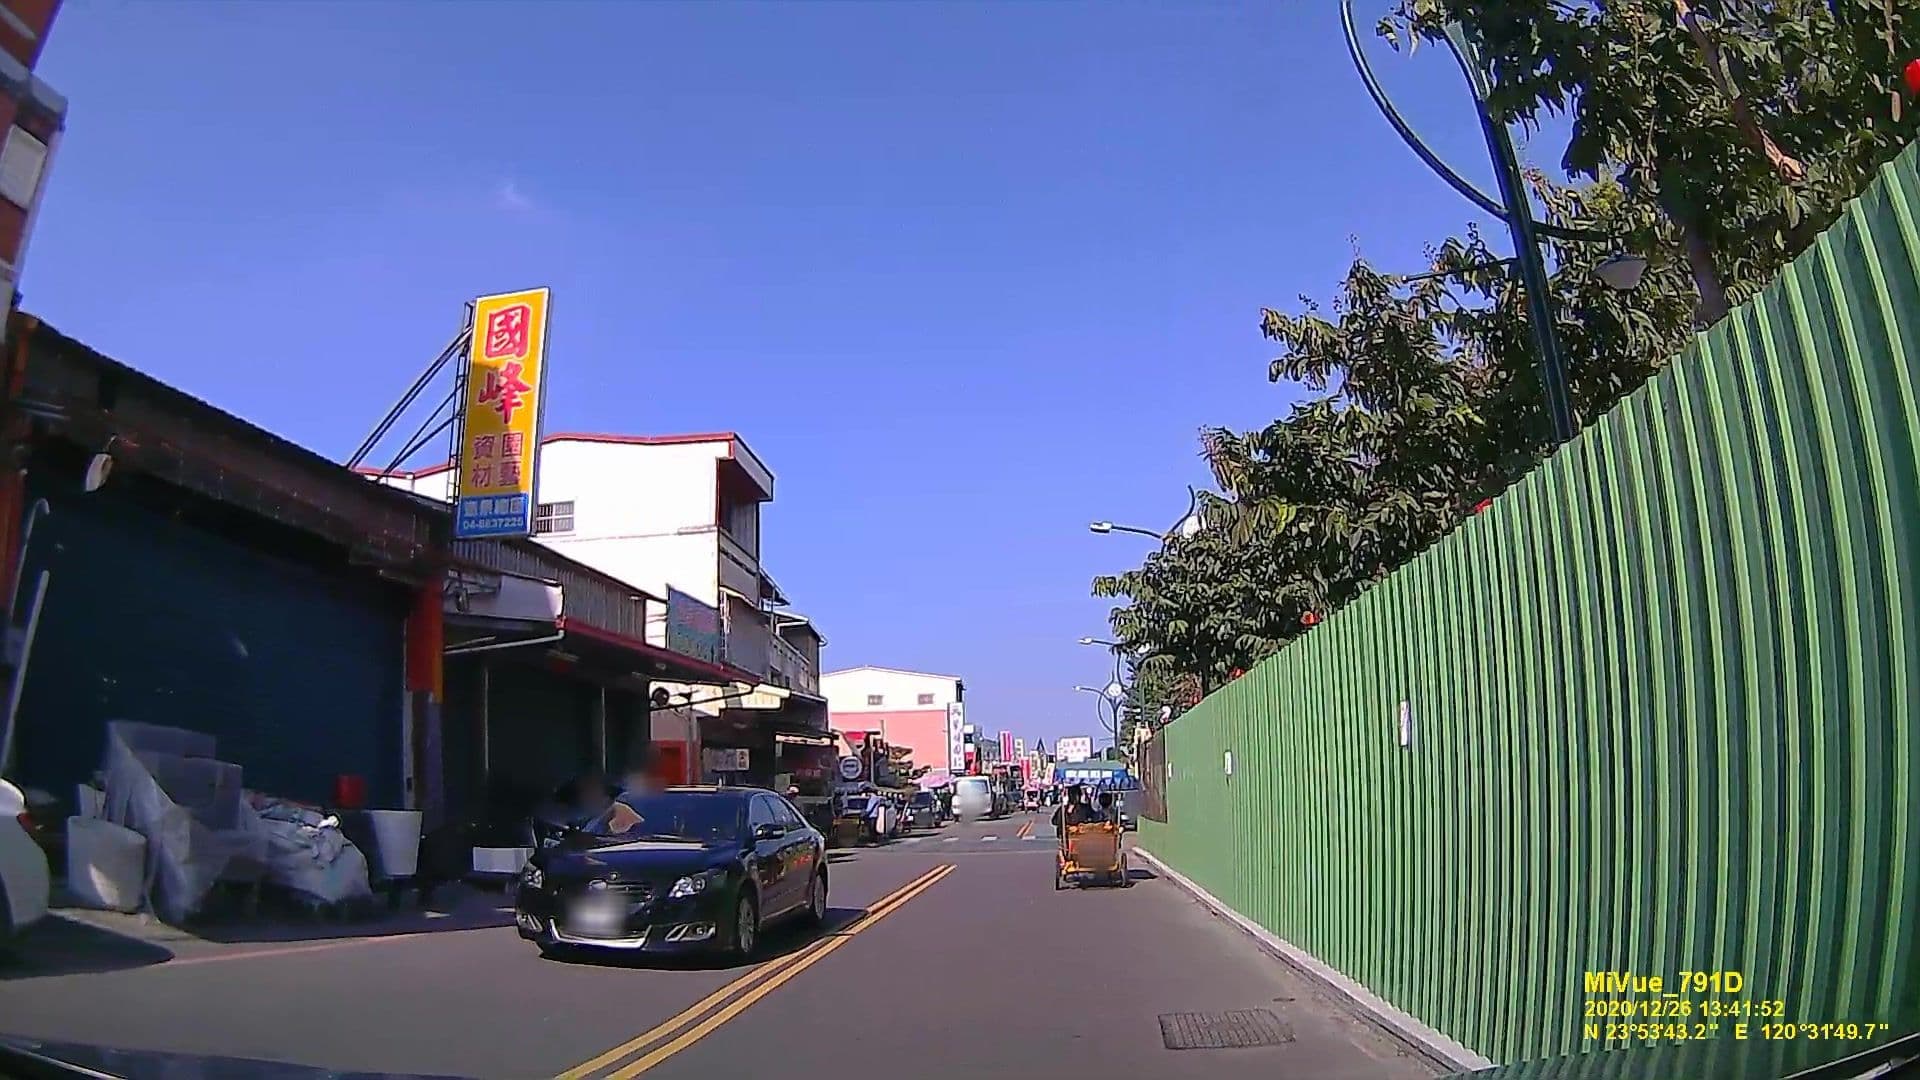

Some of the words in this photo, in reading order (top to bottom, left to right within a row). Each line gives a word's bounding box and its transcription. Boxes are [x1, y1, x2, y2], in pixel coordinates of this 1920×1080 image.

[479, 305, 530, 424] 國峰
[472, 436, 496, 488] 資材
[499, 432, 523, 487] 園藝
